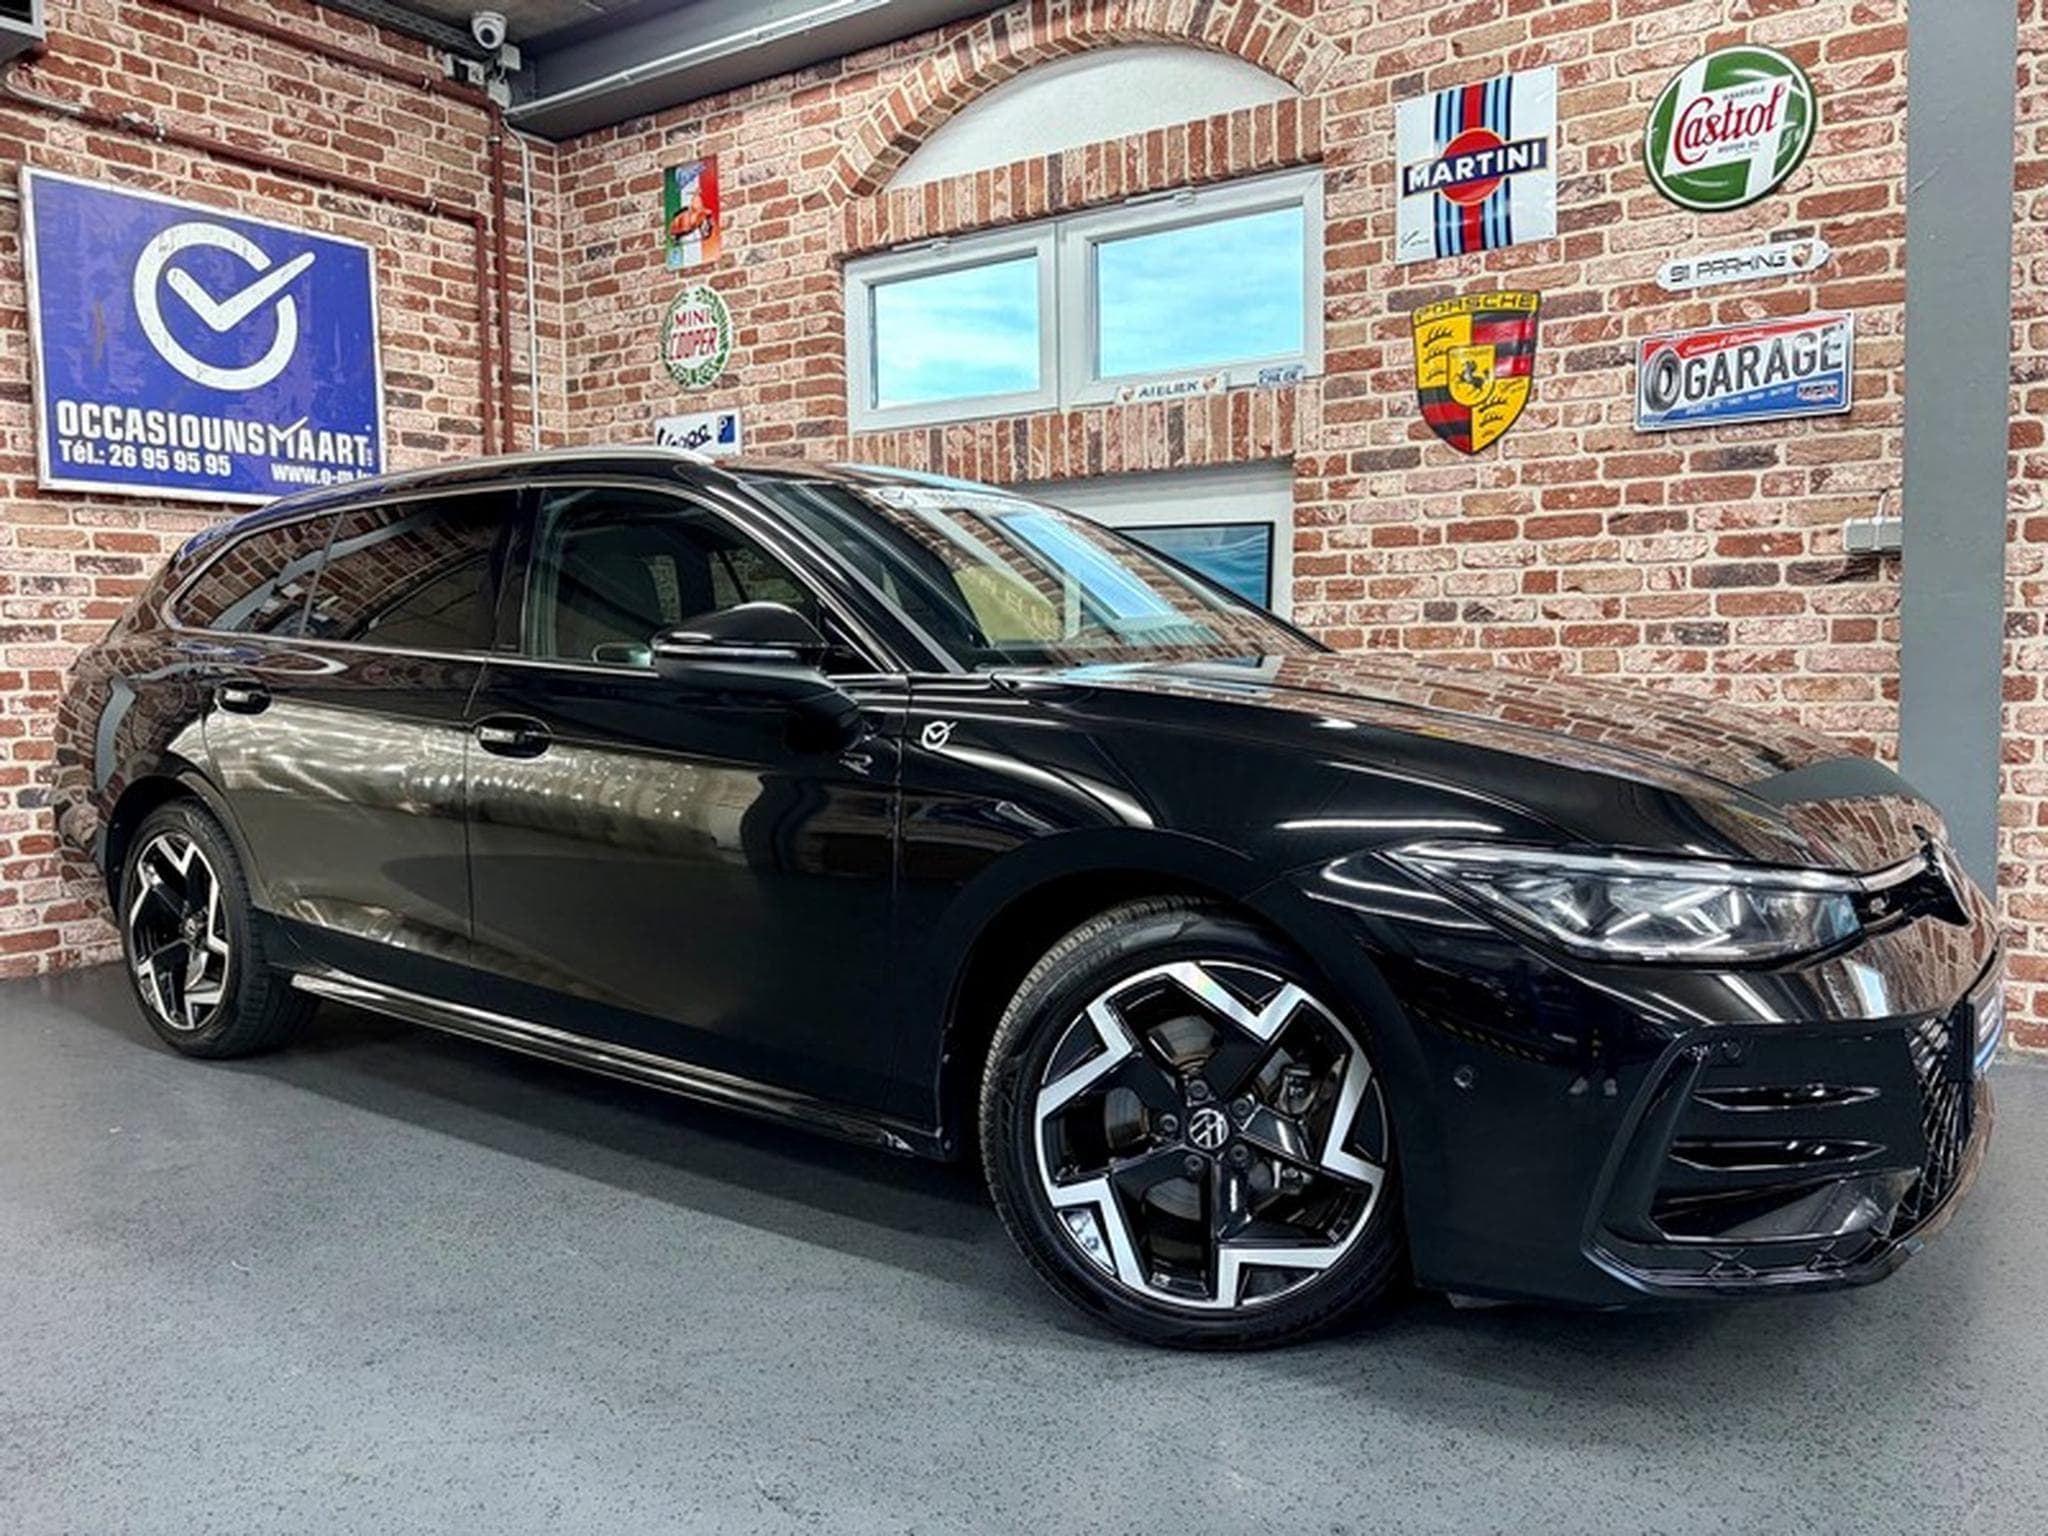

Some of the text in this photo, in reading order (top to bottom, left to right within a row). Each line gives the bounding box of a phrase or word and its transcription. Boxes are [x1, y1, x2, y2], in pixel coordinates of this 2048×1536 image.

[1674, 82, 1786, 166] Castrol
[1408, 142, 1540, 192] MARTINI
[1696, 250, 1787, 277] PARKING
[675, 310, 710, 327] MINI
[669, 327, 718, 361] COOPER
[1684, 325, 1843, 402] GARAGE
[109, 444, 136, 468] 26
[142, 447, 170, 472] 95
[174, 450, 201, 475] 95
[205, 453, 231, 477] 95
